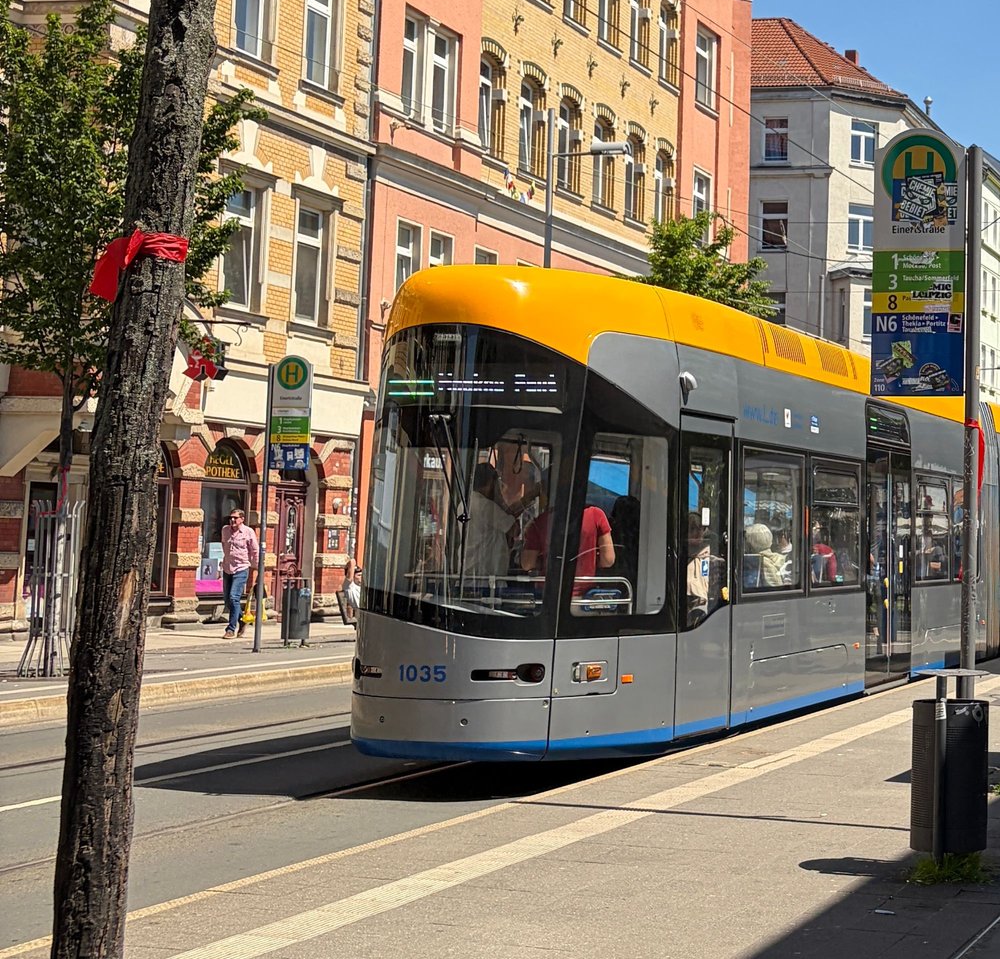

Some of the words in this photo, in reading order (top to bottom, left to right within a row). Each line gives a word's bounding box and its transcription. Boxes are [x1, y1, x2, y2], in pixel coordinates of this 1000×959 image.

[908, 179, 937, 197] CHEMIE
[891, 253, 898, 270] 1
[888, 274, 898, 290] 3
[888, 294, 897, 310] 8
[876, 315, 898, 332] N6
[286, 364, 299, 382] H
[874, 384, 885, 392] 110
[277, 425, 281, 434] 3
[276, 434, 281, 442] 8
[399, 664, 447, 682] 1035
